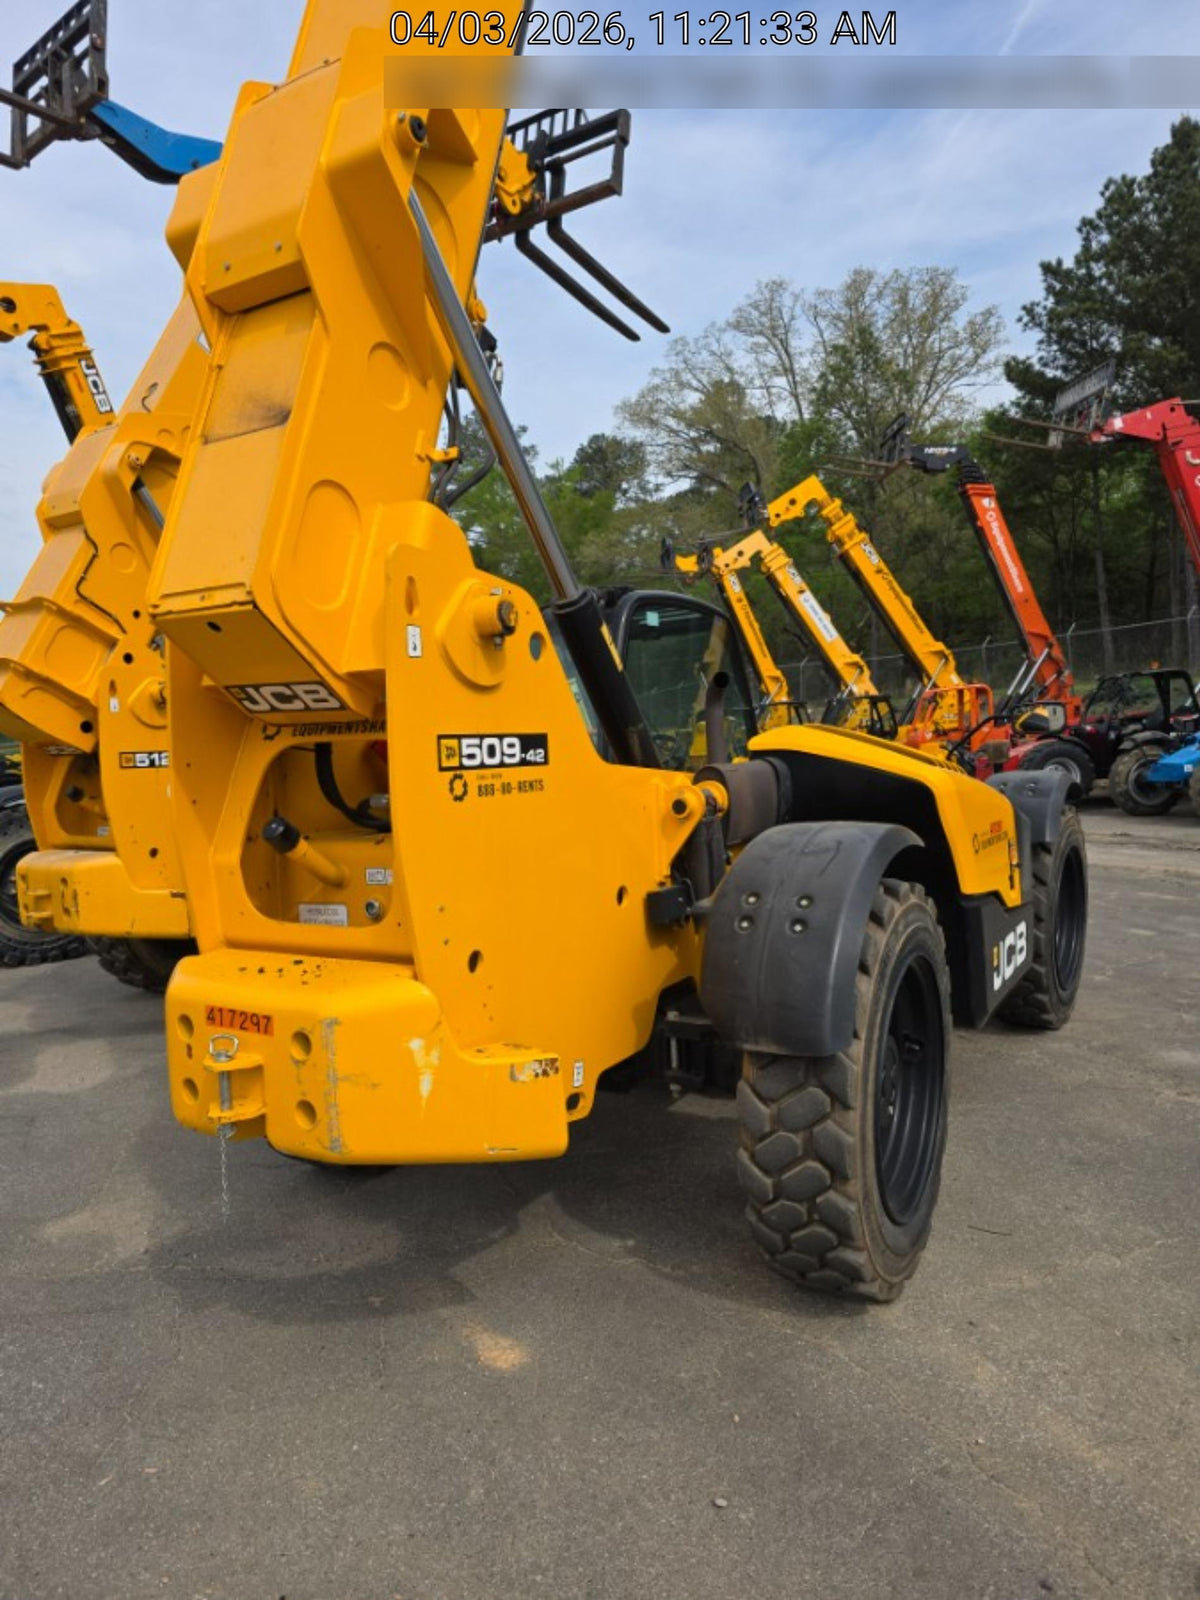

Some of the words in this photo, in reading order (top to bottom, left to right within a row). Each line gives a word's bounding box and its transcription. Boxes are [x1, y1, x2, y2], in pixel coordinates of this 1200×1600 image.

[81, 360, 111, 412] JCB
[241, 683, 341, 711] JCB
[993, 920, 1027, 991] JCB
[207, 1007, 272, 1034] 417297
